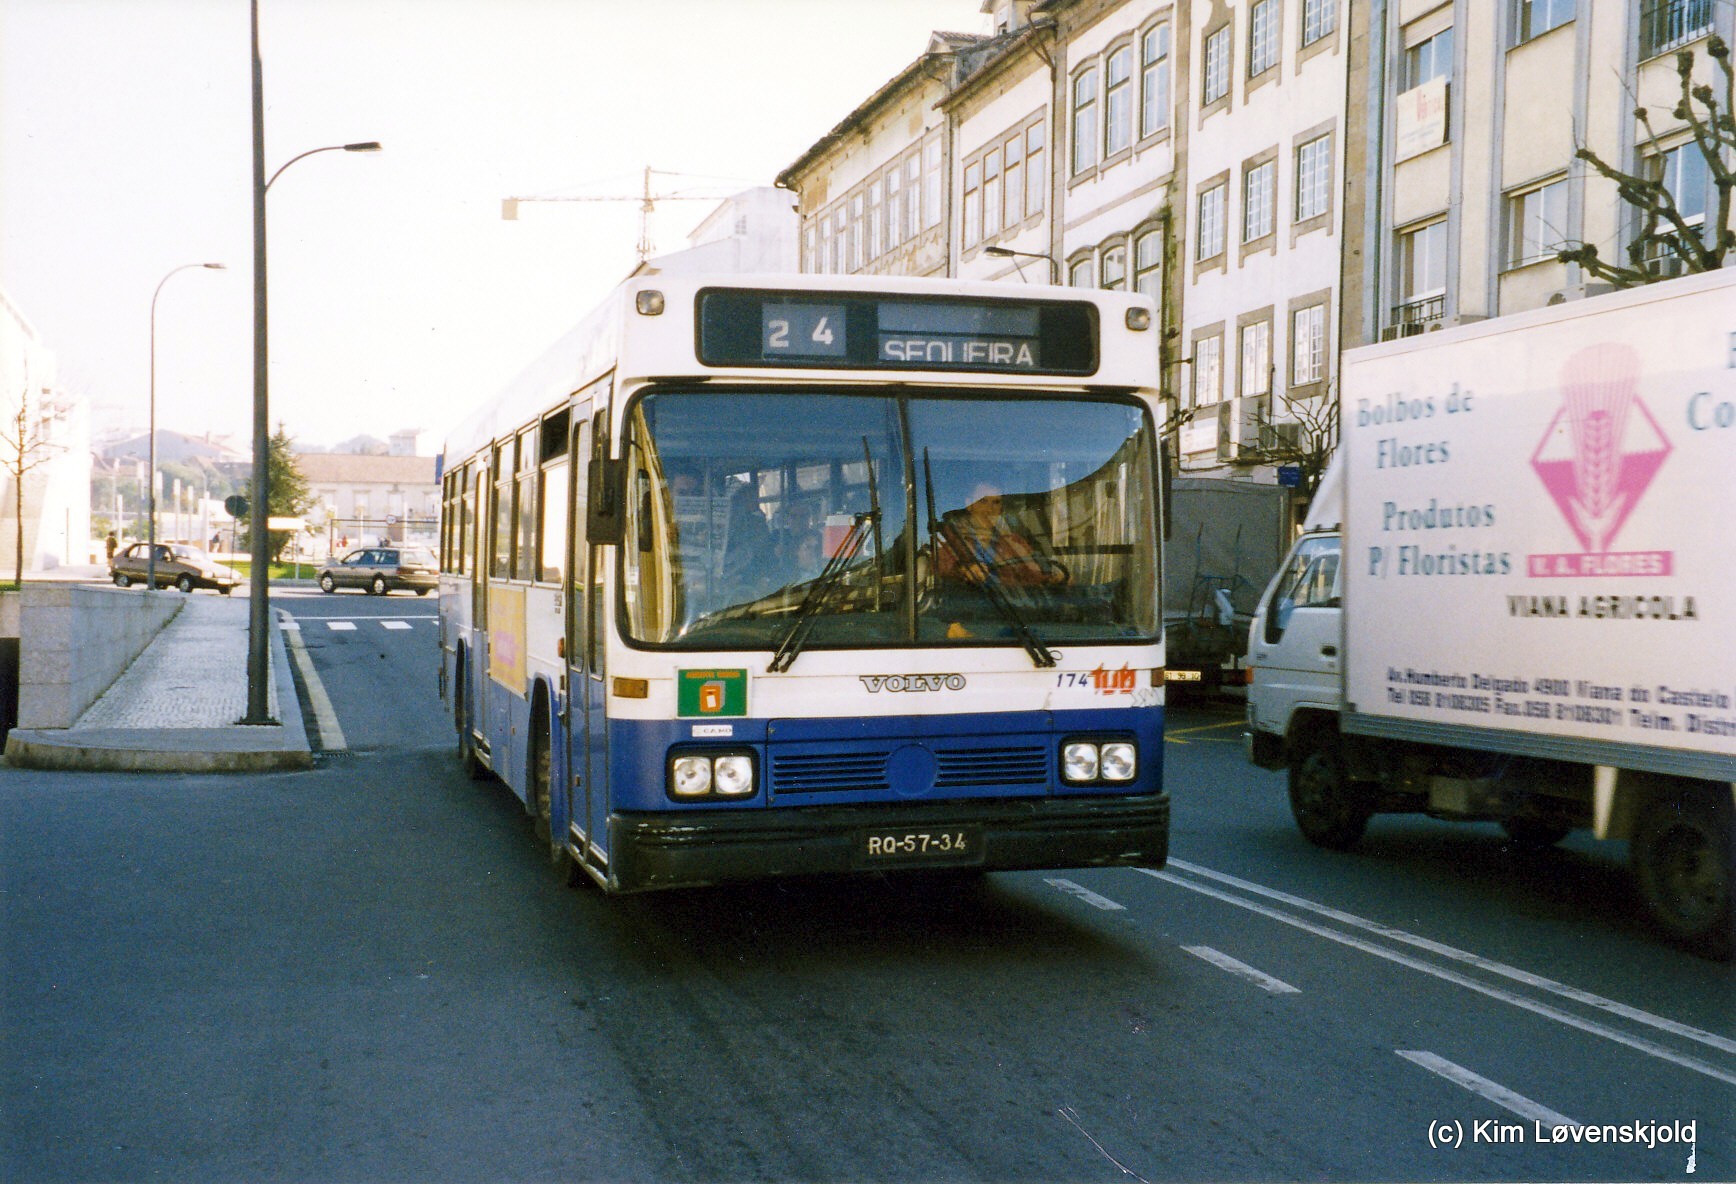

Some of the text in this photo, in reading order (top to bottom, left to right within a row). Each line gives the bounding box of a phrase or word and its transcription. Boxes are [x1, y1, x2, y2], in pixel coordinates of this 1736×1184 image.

[1357, 377, 1475, 427] Bolbos de
[1377, 437, 1449, 469] Flores
[1383, 498, 1496, 532] Produtos
[1397, 544, 1512, 576] Floristas
[1581, 553, 1665, 575] FLORES
[1506, 594, 1569, 619] VIANA
[859, 673, 967, 693] VOLVO
[1057, 673, 1088, 688] 174
[1575, 680, 1623, 702] Viana
[868, 832, 967, 855] RQ-57-34
